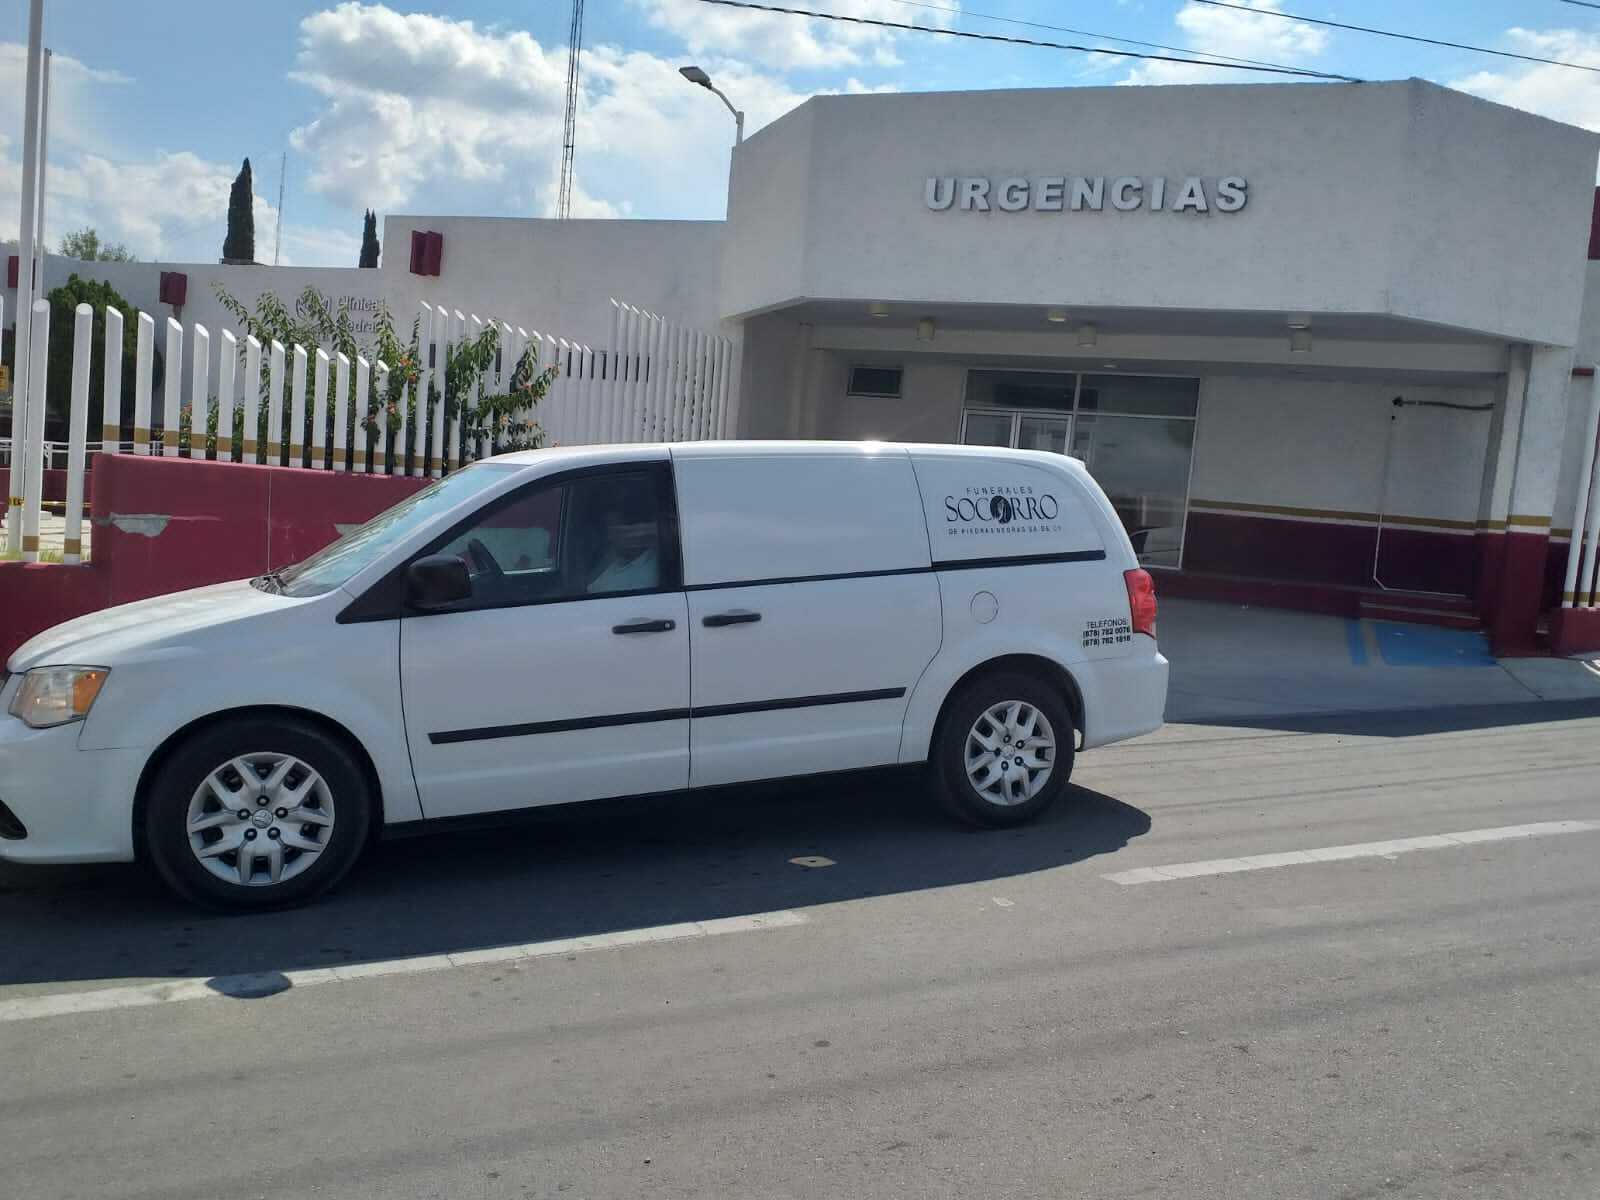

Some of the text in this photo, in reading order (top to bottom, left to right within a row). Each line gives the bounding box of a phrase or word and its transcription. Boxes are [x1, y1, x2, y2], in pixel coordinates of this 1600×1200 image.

[925, 176, 1249, 213] URGENCIAS
[966, 486, 1033, 496] FUNERALES
[944, 494, 1059, 524] SOCORRO
